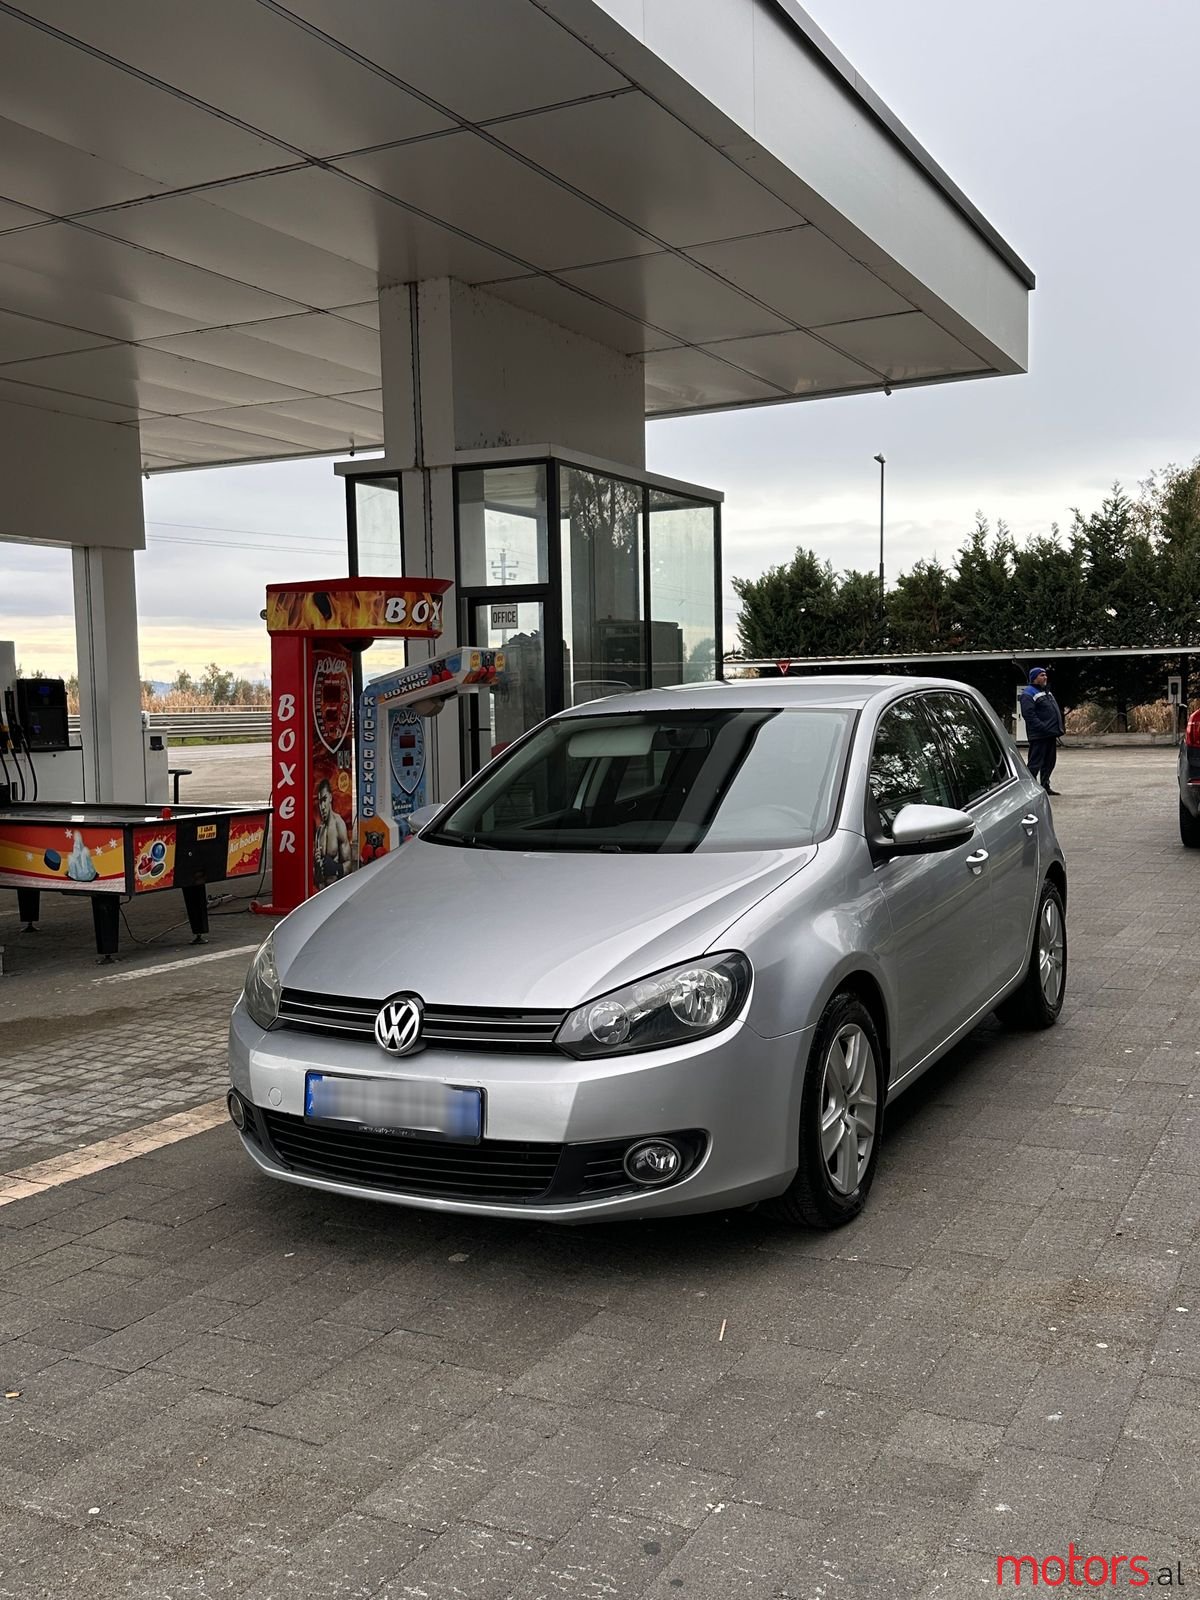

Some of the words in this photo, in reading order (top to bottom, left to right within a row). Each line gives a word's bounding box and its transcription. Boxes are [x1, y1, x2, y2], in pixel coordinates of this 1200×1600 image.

[385, 597, 441, 624] BOX
[492, 611, 517, 624] OFFICE
[384, 678, 430, 699] BOXING
[398, 670, 428, 685] KIDS
[363, 695, 375, 742] KIDS
[362, 748, 375, 818] BOXING
